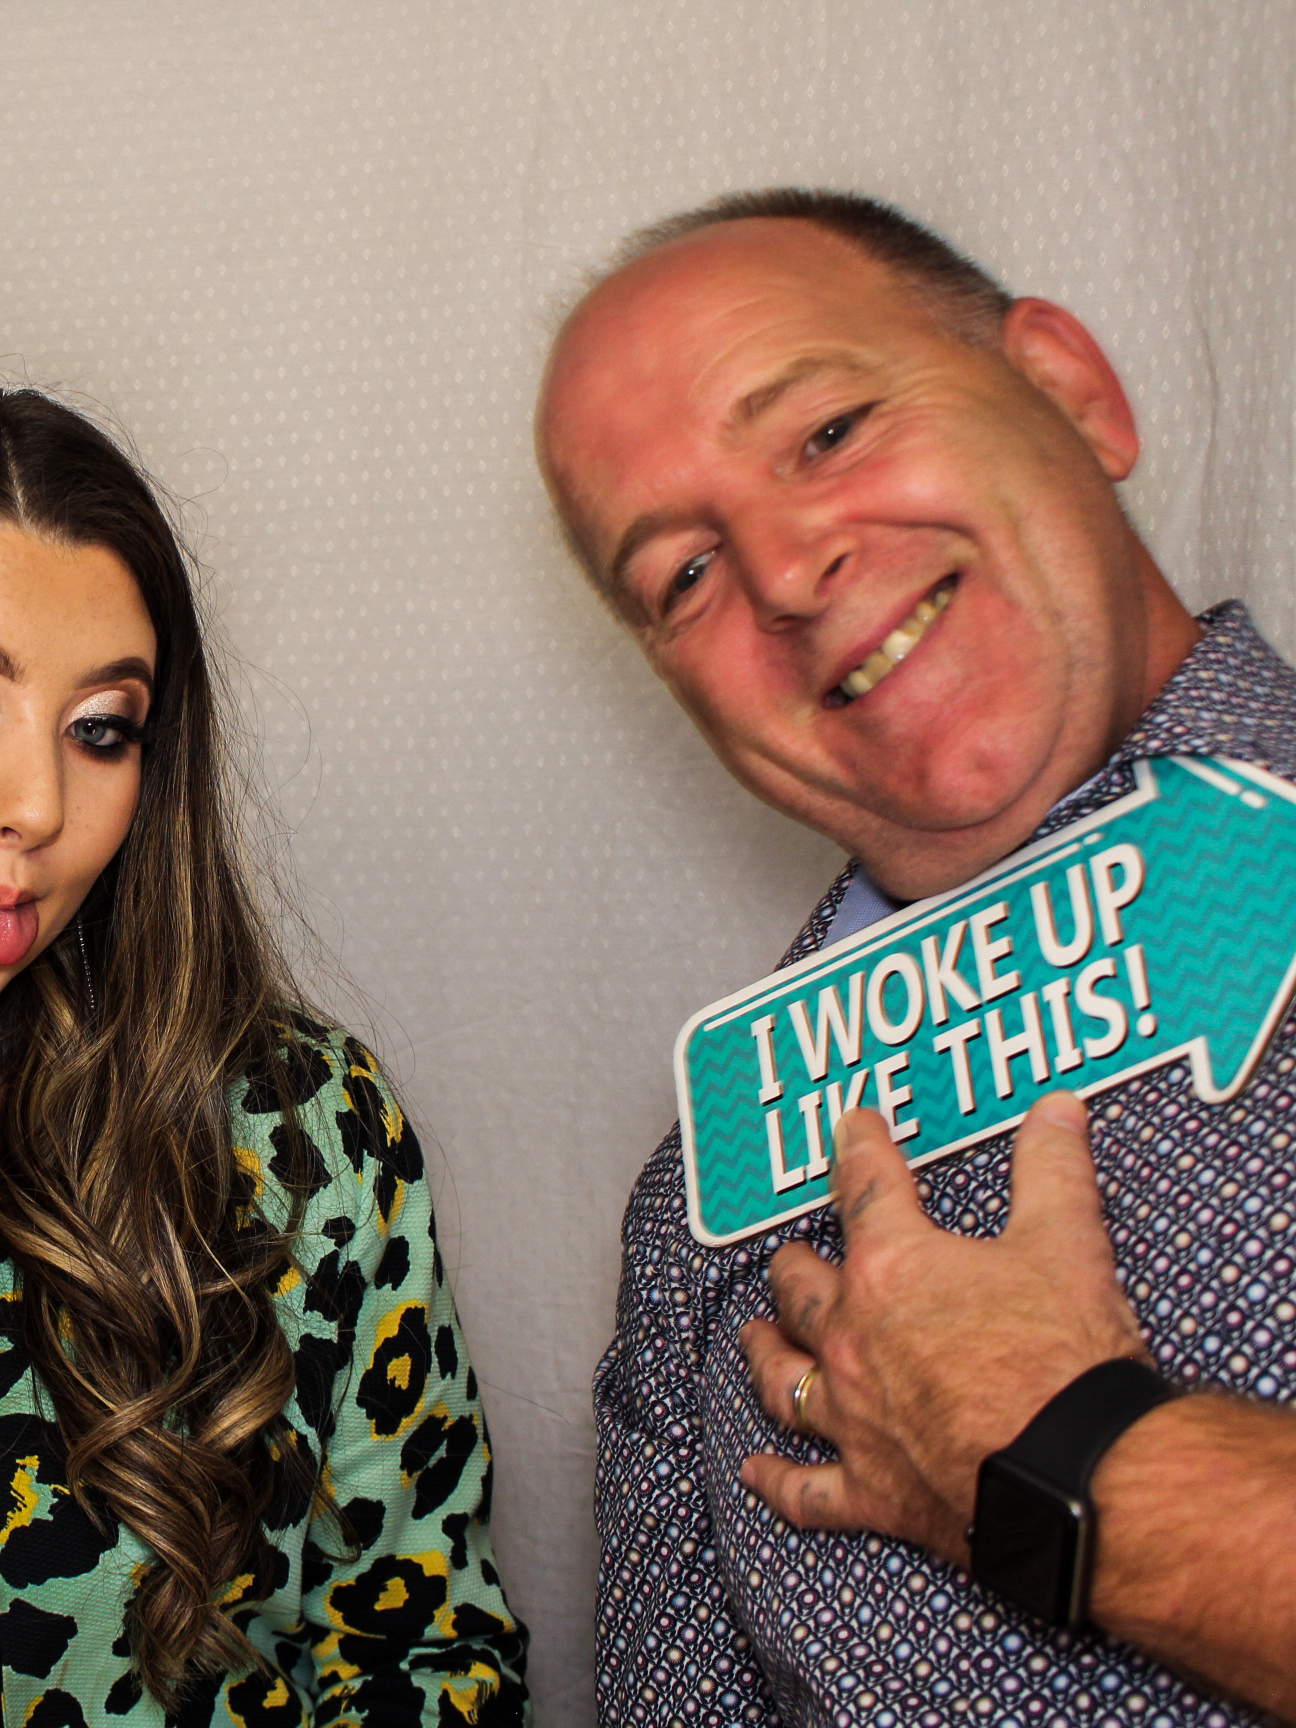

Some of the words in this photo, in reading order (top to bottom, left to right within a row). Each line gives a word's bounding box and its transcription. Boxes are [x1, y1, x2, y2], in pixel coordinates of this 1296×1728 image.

[750, 1014, 783, 1105] I
[788, 901, 1022, 1082] WOKE
[1030, 843, 1146, 968] UP
[933, 944, 1158, 1115] THIS!
